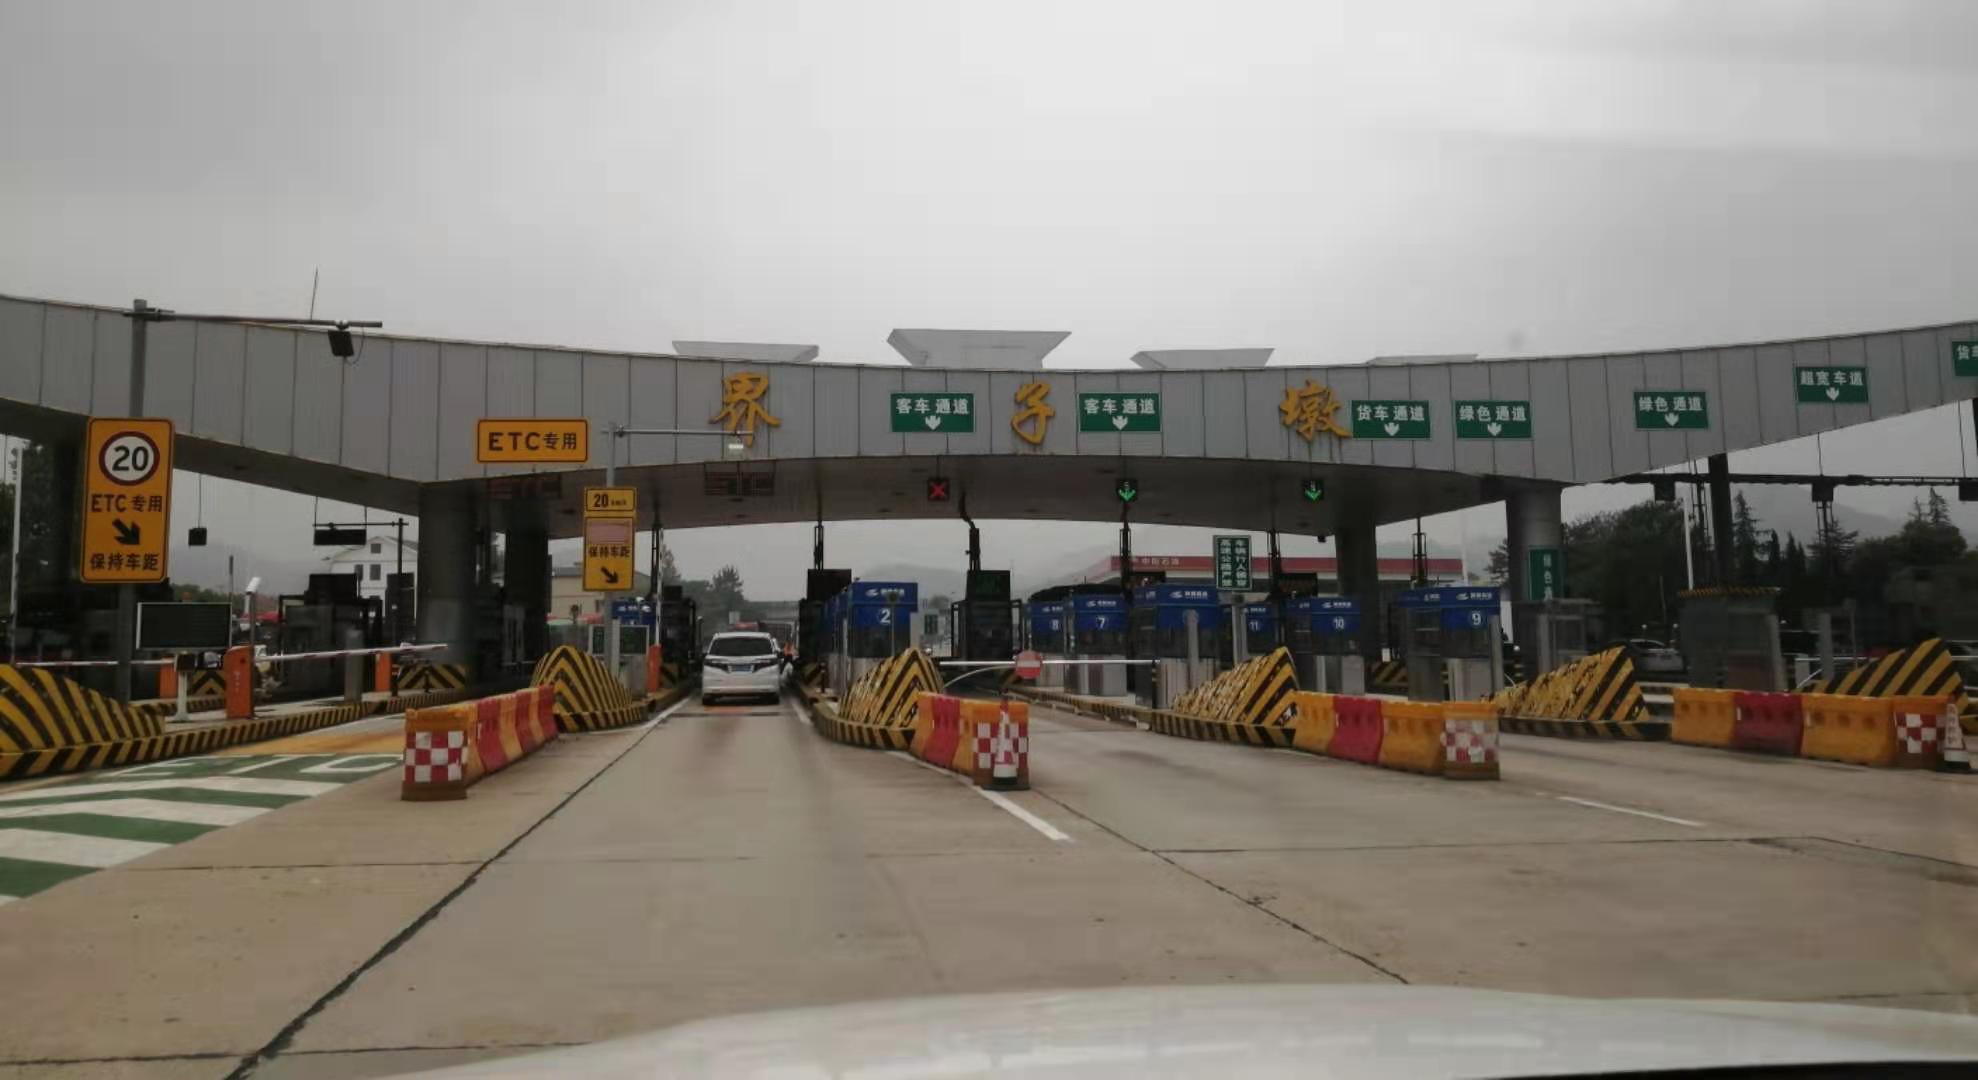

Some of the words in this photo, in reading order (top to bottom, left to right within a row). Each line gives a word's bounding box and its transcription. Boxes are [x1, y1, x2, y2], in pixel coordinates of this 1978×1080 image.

[1800, 371, 1864, 387] 超宽车道
[710, 372, 782, 448] 界
[896, 397, 970, 415] 客车通道
[1084, 397, 1156, 415] 客车通道
[1280, 380, 1352, 443] 墩
[1356, 404, 1425, 422] 货车通道
[1638, 396, 1703, 412] 绿色通道
[1011, 382, 1055, 445] 子
[1459, 405, 1527, 422] 绿色通道
[488, 432, 578, 451] ETC专用
[113, 445, 148, 472] 20
[91, 494, 127, 513] ETC
[132, 495, 163, 512] 专用
[593, 492, 609, 508] 20
[588, 545, 631, 558] 保持车距
[89, 553, 160, 571] 保持车距
[880, 609, 891, 624] 2
[1096, 615, 1106, 629] 7
[1472, 612, 1481, 626] 9
